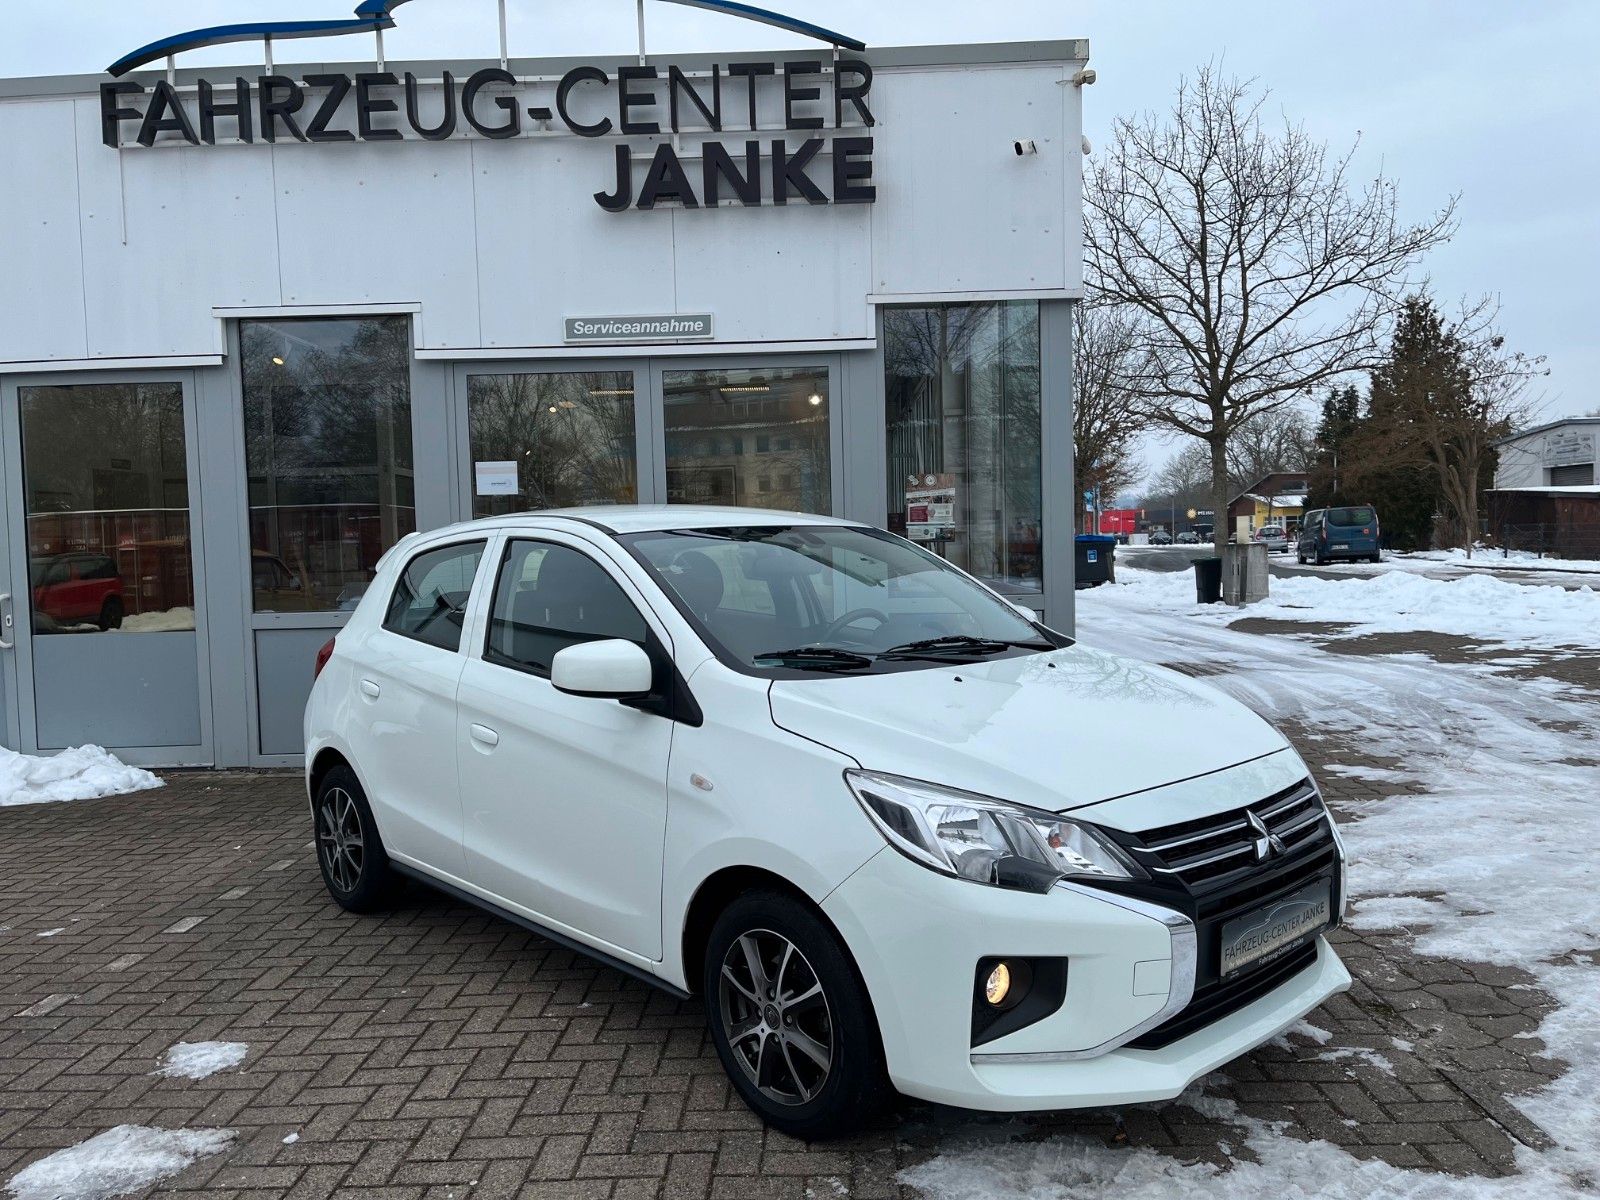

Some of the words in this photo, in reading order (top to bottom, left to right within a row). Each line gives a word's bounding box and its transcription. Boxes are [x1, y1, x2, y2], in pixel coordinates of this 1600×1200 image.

[101, 60, 875, 148] FAHRZEUG-CENTER
[594, 136, 876, 212] JANKE
[573, 319, 704, 335] Serviceannahme
[1225, 914, 1300, 960] FAHRZEUG-CENTER
[1301, 901, 1325, 924] JANKE
